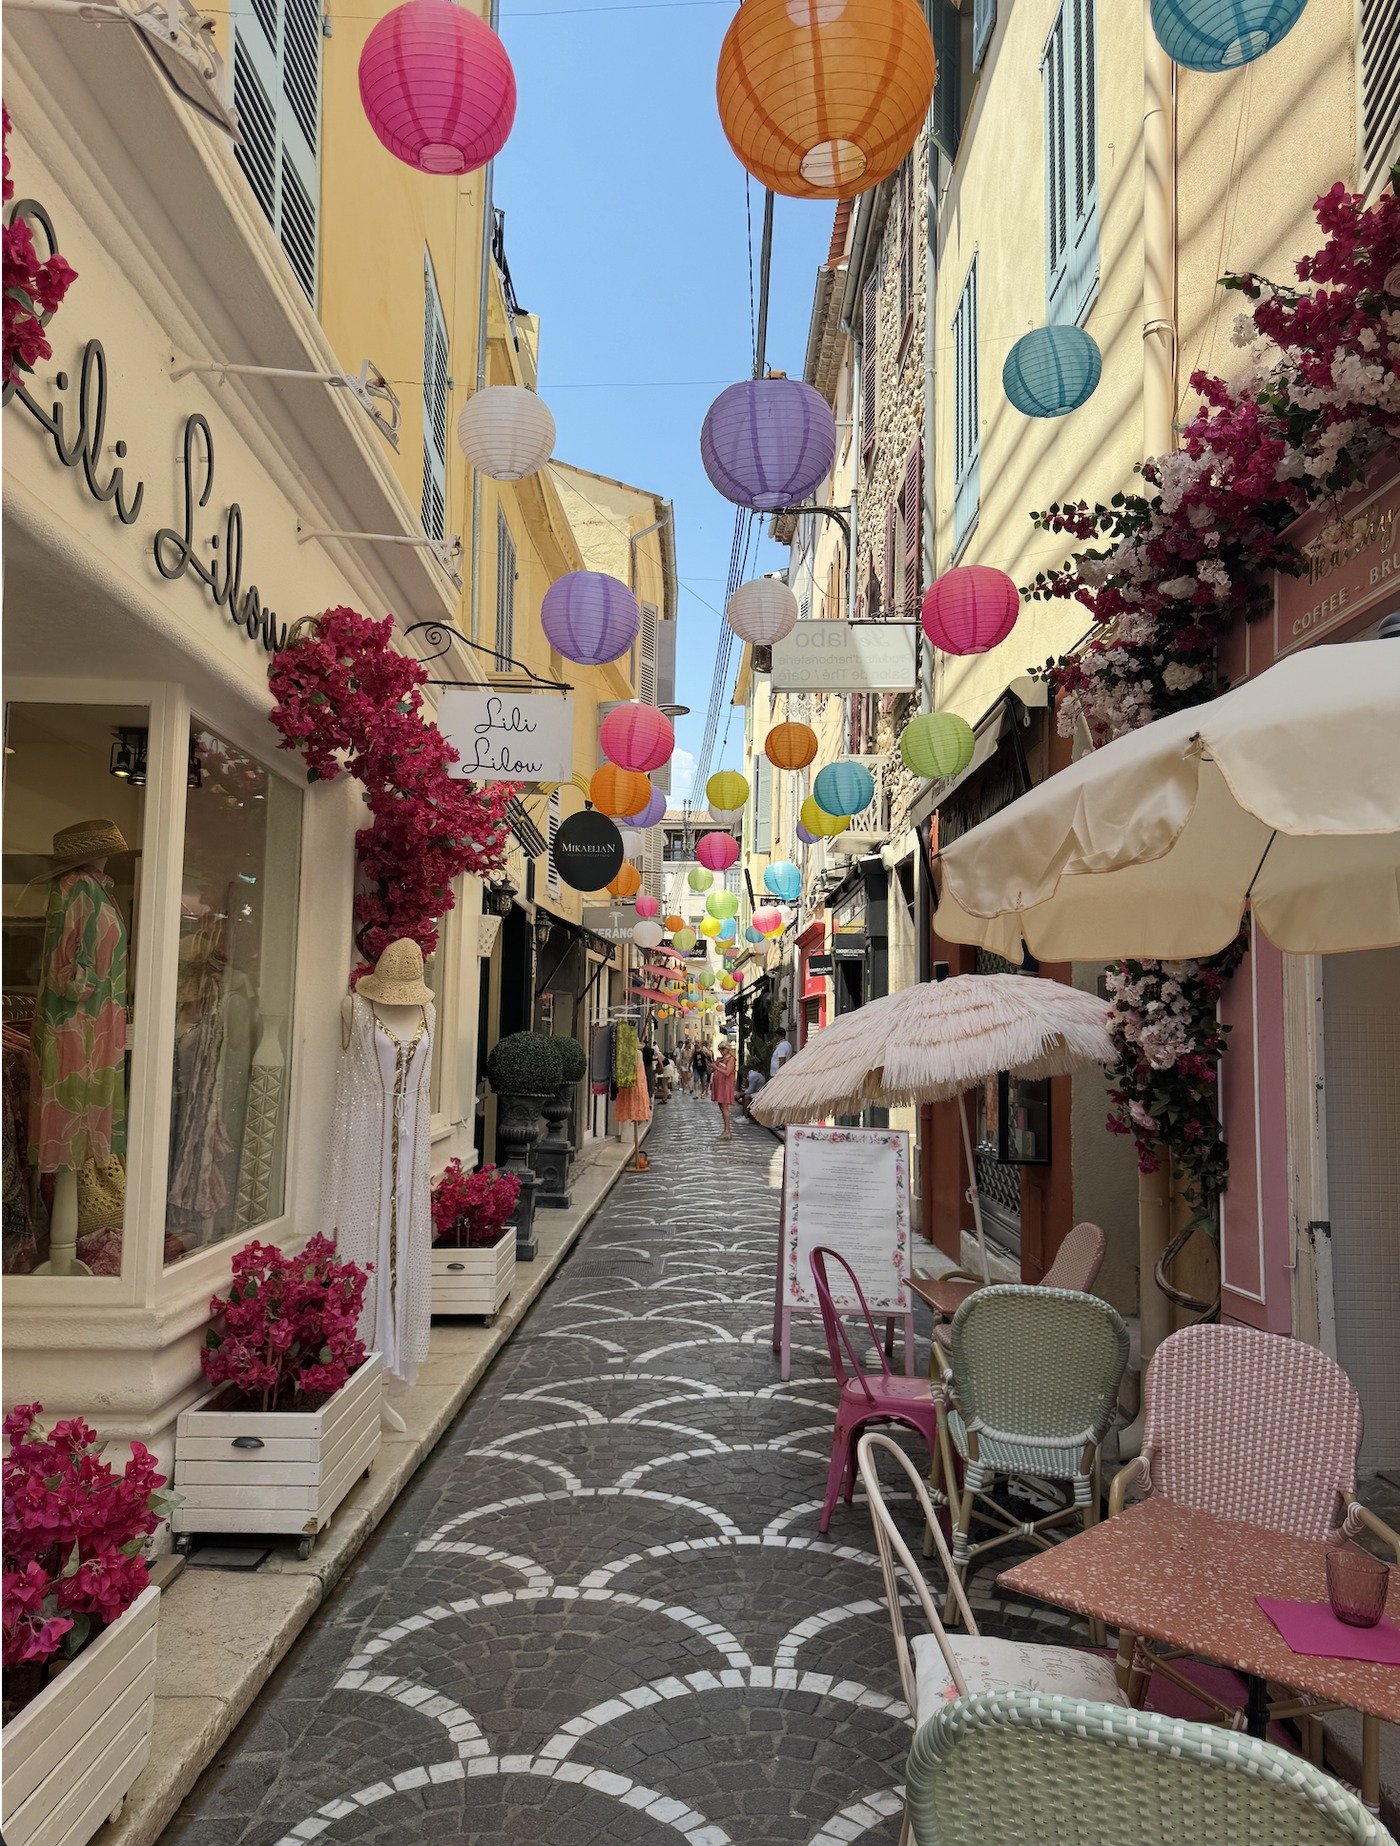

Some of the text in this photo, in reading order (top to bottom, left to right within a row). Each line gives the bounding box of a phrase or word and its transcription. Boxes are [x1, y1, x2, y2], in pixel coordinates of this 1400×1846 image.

[154, 413, 287, 653] Lilou
[1292, 586, 1349, 635] COFFEE
[474, 697, 537, 734] Lili
[461, 737, 543, 774] Lilou
